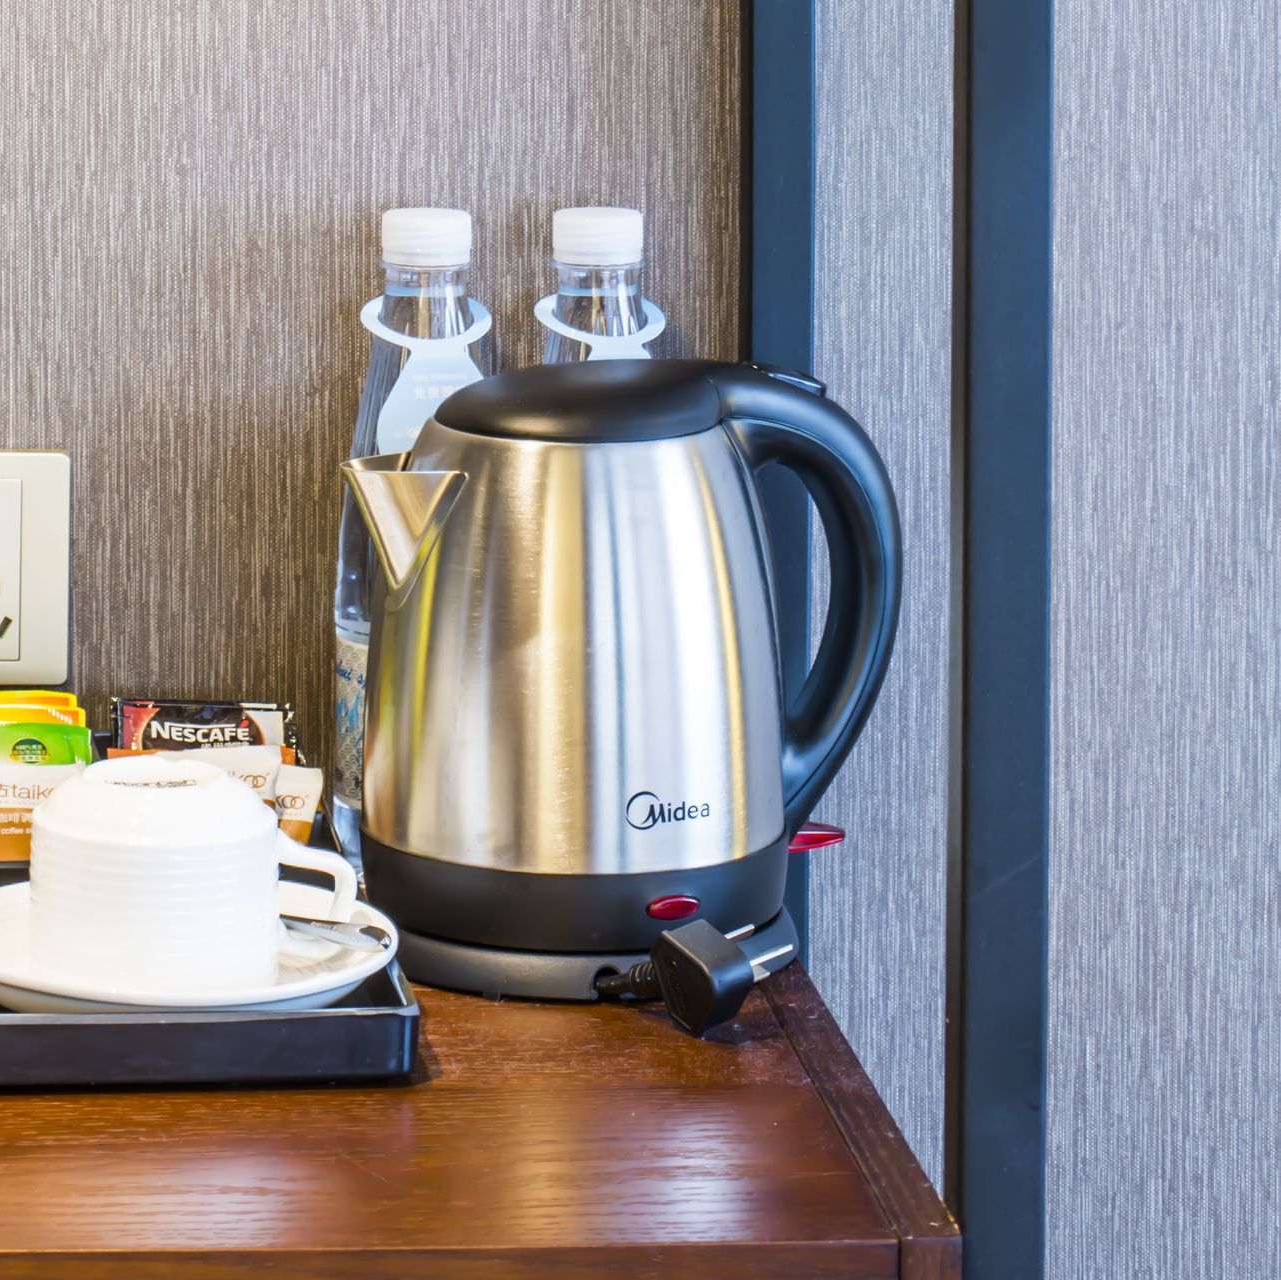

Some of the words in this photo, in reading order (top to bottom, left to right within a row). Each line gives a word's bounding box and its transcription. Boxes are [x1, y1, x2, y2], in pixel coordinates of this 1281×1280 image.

[150, 720, 251, 743] NESCAFÉ
[625, 791, 710, 831] Midea
[0, 826, 25, 836] coffee
